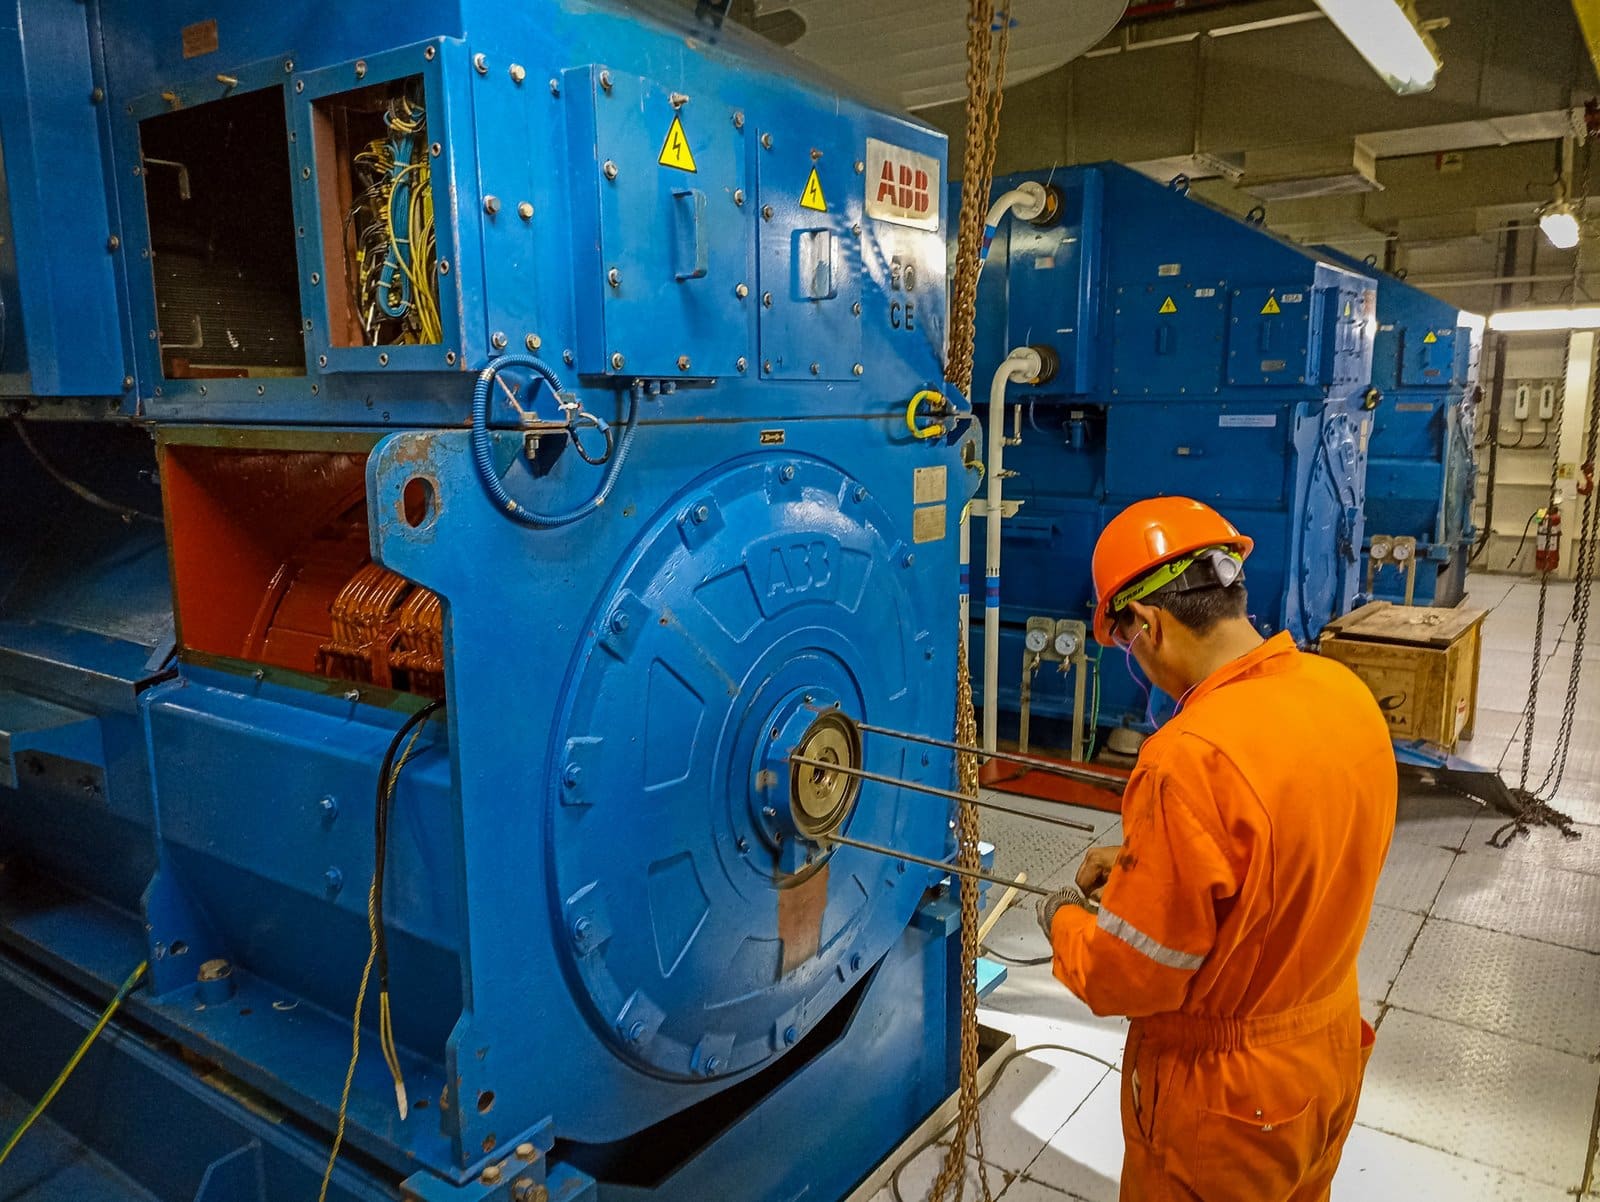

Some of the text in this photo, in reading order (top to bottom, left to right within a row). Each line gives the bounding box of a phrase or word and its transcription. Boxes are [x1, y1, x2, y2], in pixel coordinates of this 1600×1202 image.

[877, 160, 929, 212] ABB
[891, 301, 914, 331] CE
[766, 541, 831, 597] ABB
